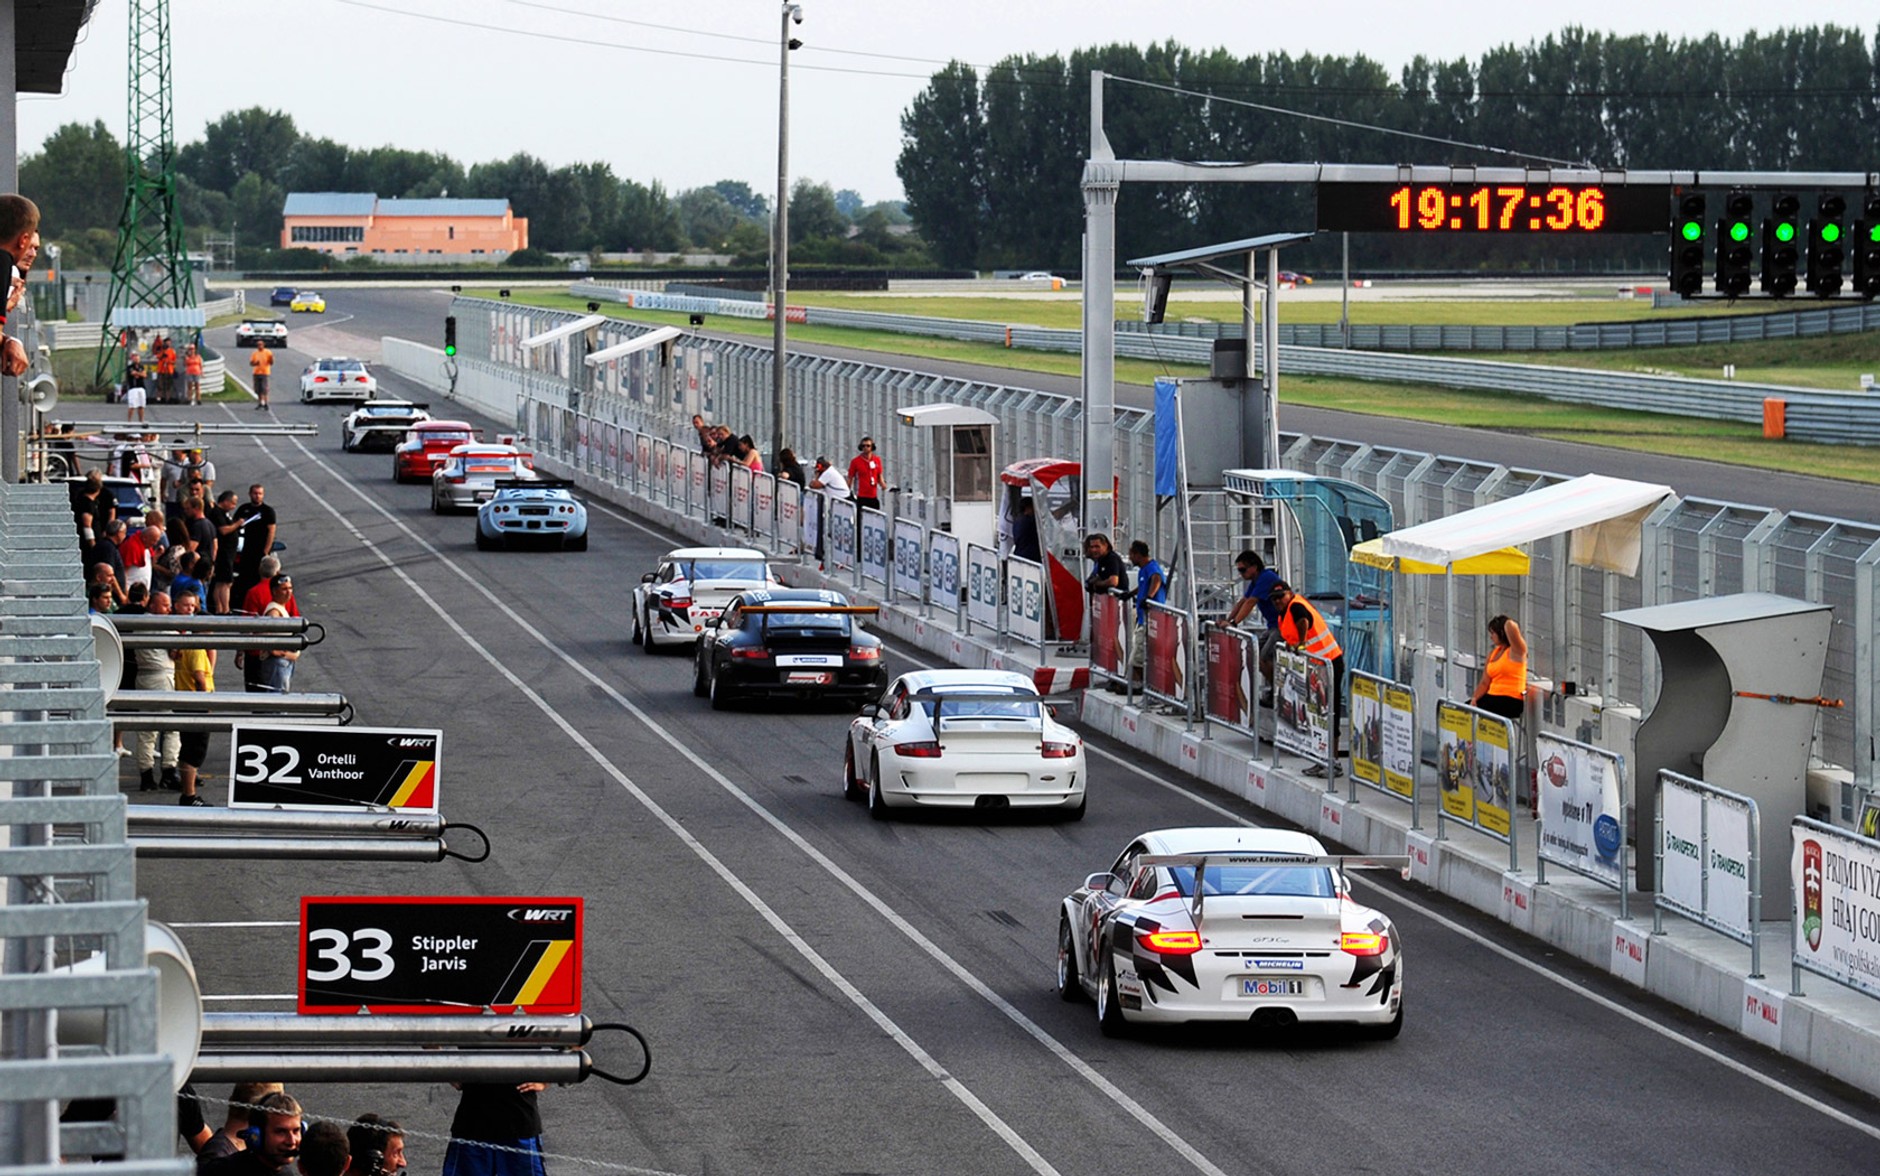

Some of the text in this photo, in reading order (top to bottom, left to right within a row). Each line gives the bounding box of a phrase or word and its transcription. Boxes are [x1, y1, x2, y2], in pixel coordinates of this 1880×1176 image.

[1391, 188, 1604, 229] 19:17:36
[399, 737, 435, 747] WRT
[236, 744, 302, 784] 32
[317, 753, 356, 765] Ortelli
[308, 768, 364, 780] Vanthoor
[1229, 856, 1318, 864] www.Lisowski.pl
[523, 909, 573, 921] WRT
[1832, 896, 1856, 942] HRAJ
[412, 936, 478, 953] Stippler
[1615, 935, 1643, 963] PIT WALL
[307, 928, 395, 982] 33
[421, 956, 467, 972] Jarvis
[1258, 960, 1302, 969] MICHELIN
[1244, 980, 1300, 994] Mobil 1
[1746, 995, 1778, 1026] PIT WALL
[506, 1025, 568, 1038] WRT
